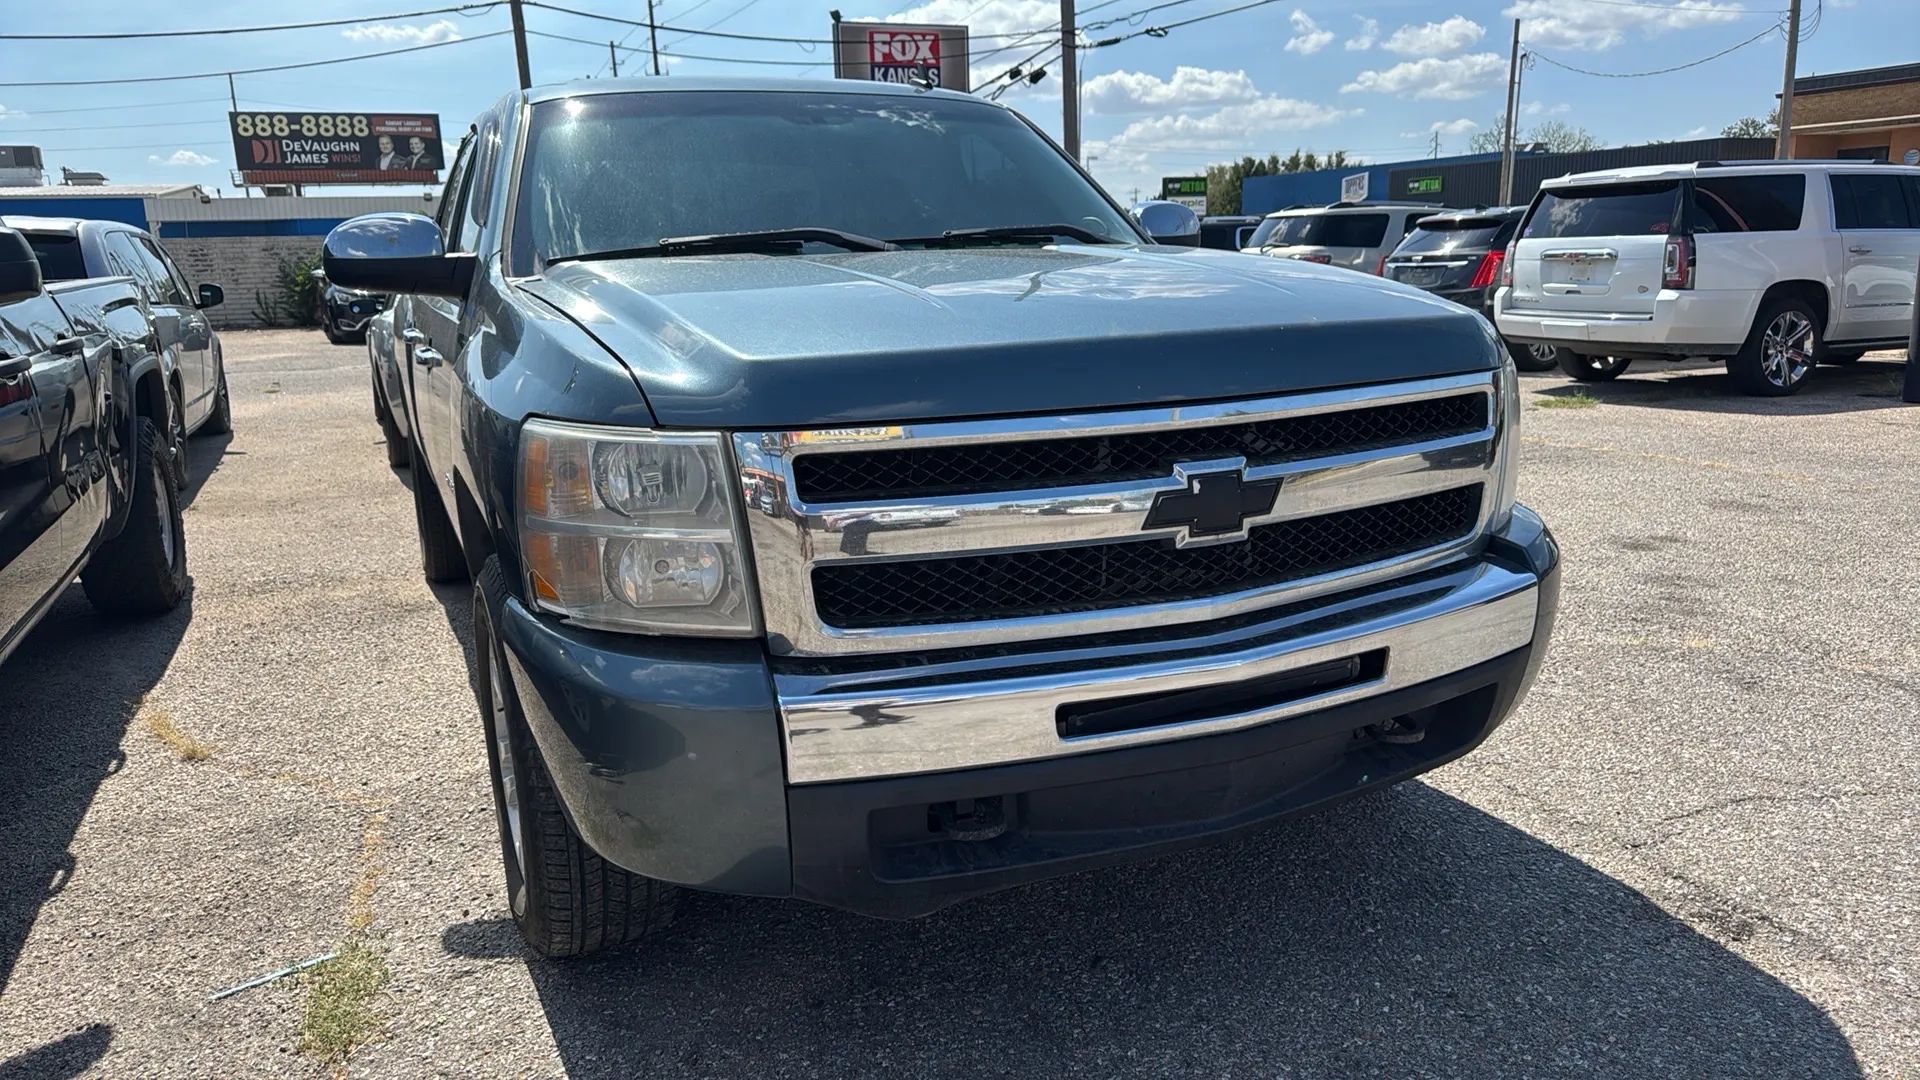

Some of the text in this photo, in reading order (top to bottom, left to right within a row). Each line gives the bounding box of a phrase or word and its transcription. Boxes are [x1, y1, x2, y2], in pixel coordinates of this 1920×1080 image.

[873, 33, 937, 63] FOX
[874, 67, 939, 87] KANSS
[237, 114, 369, 137] 888-8888
[284, 152, 329, 164] JAMES
